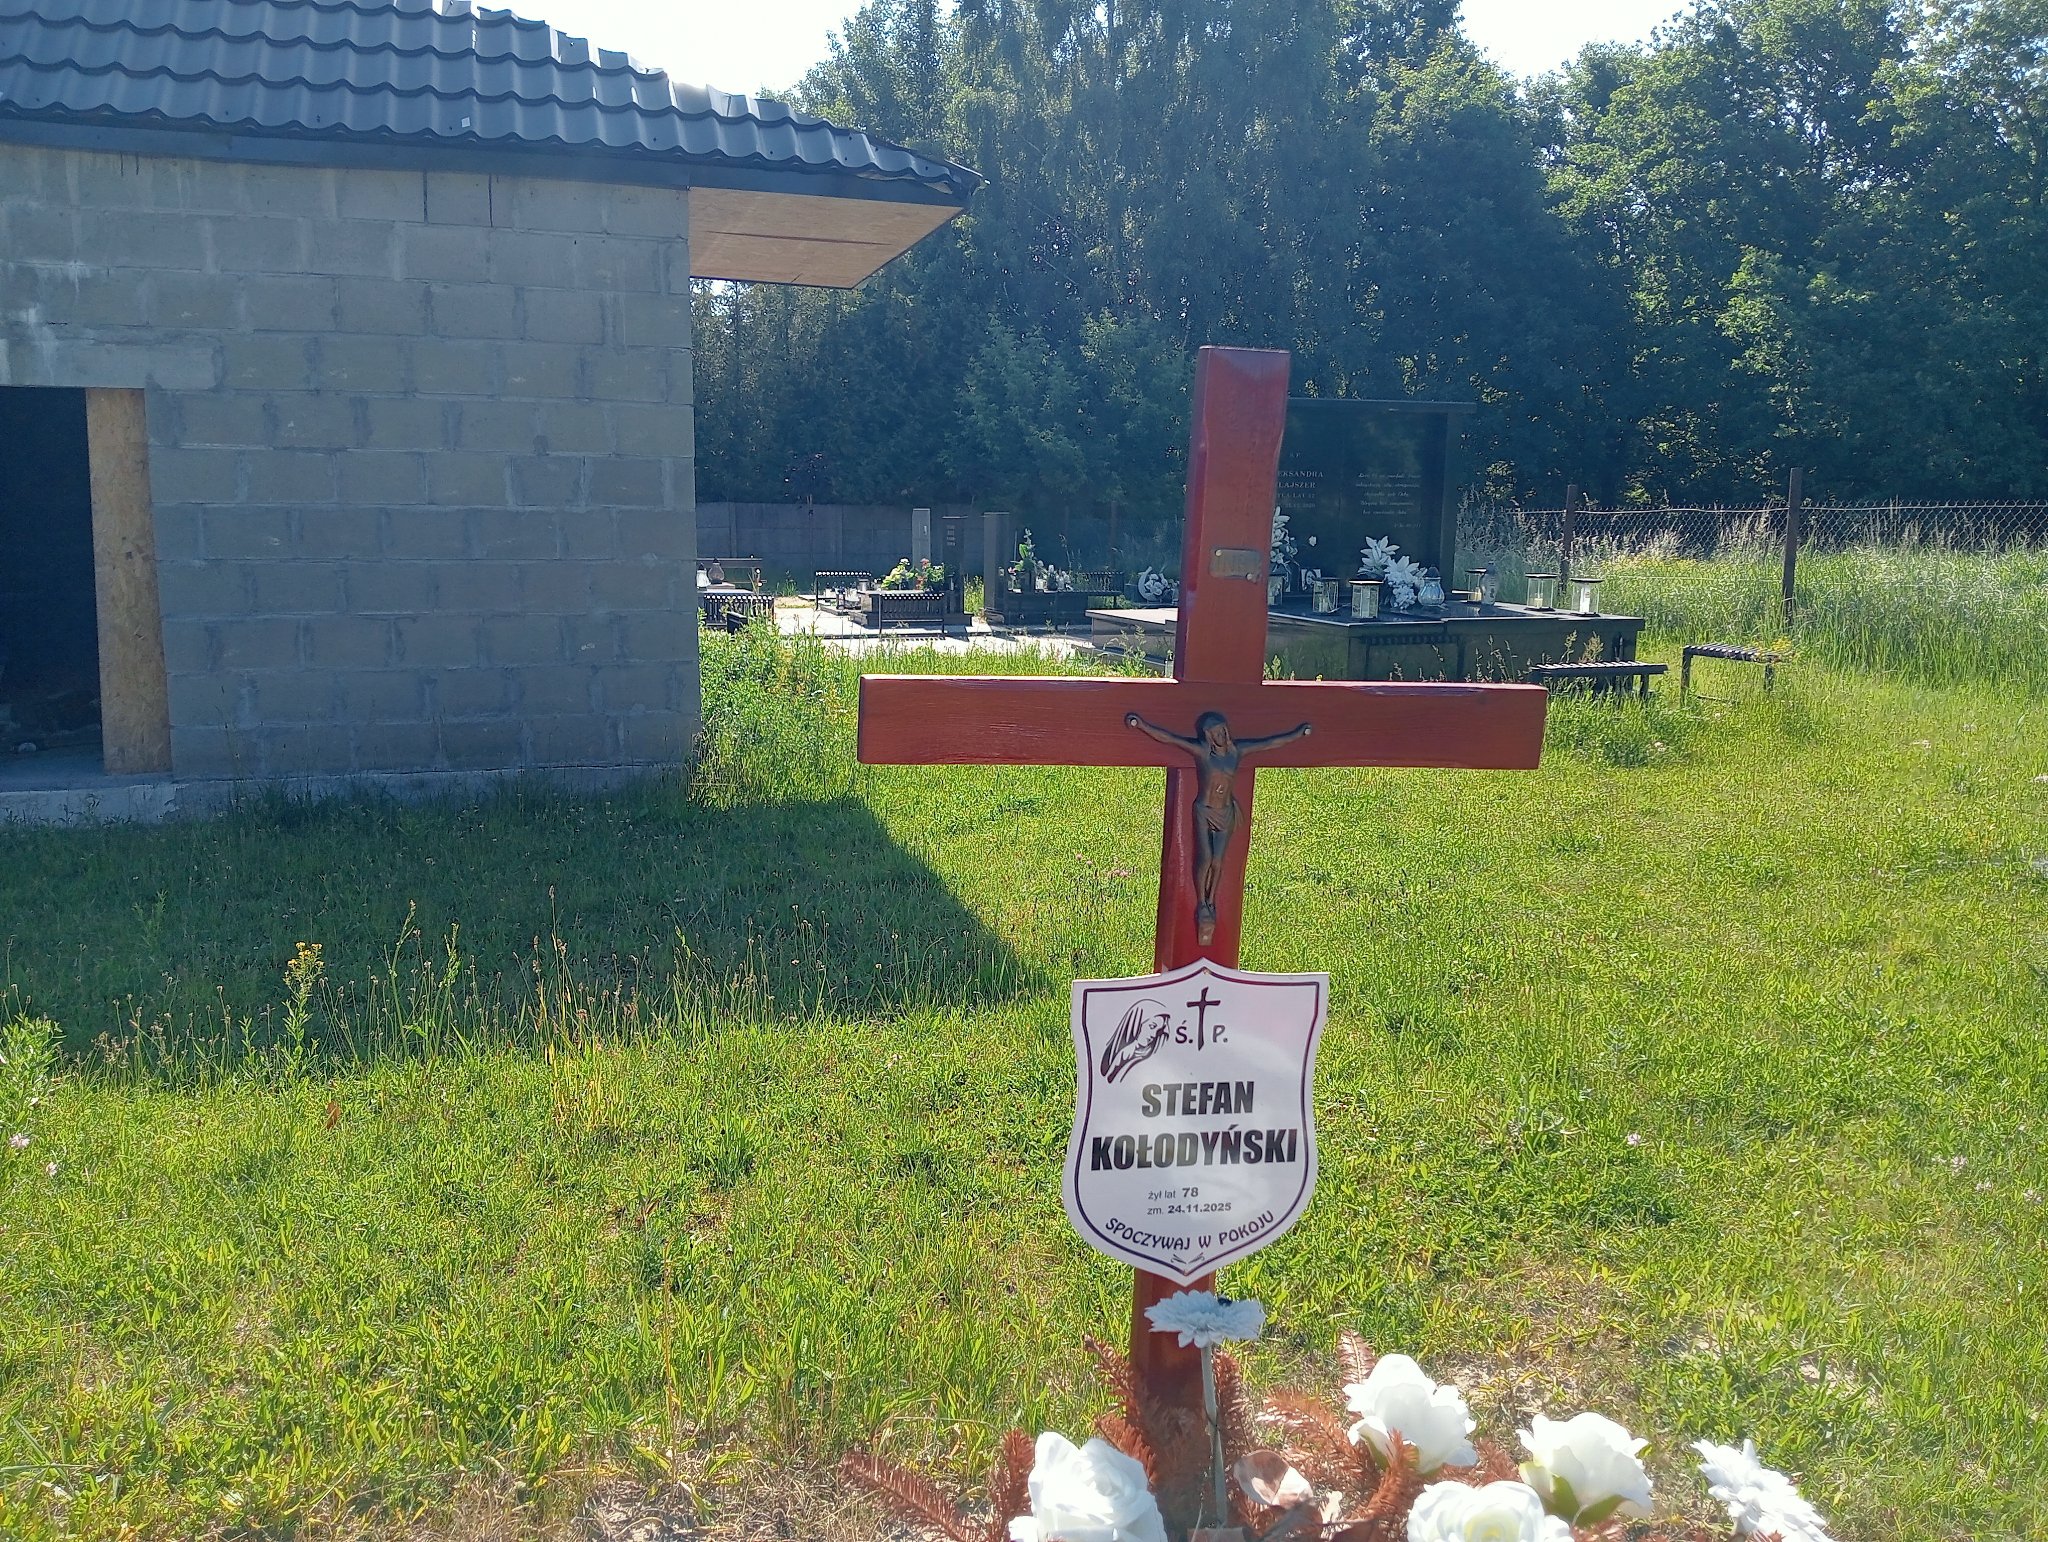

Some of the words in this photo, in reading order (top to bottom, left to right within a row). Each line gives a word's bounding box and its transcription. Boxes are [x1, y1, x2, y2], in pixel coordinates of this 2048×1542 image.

[1212, 1025, 1229, 1043] P.
[1141, 1081, 1255, 1118] STEFAN
[1090, 1124, 1298, 1171] KOŁODYŃSKI
[1147, 1191, 1162, 1201] żył
[1164, 1190, 1176, 1199] lat
[1182, 1187, 1199, 1198] 78
[1146, 1206, 1164, 1216] zm.
[1167, 1202, 1232, 1214] 24.11.2025
[1105, 1217, 1190, 1250] SPOCZYWAJ
[1199, 1235, 1211, 1248] W
[1218, 1210, 1274, 1246] POKOJU
